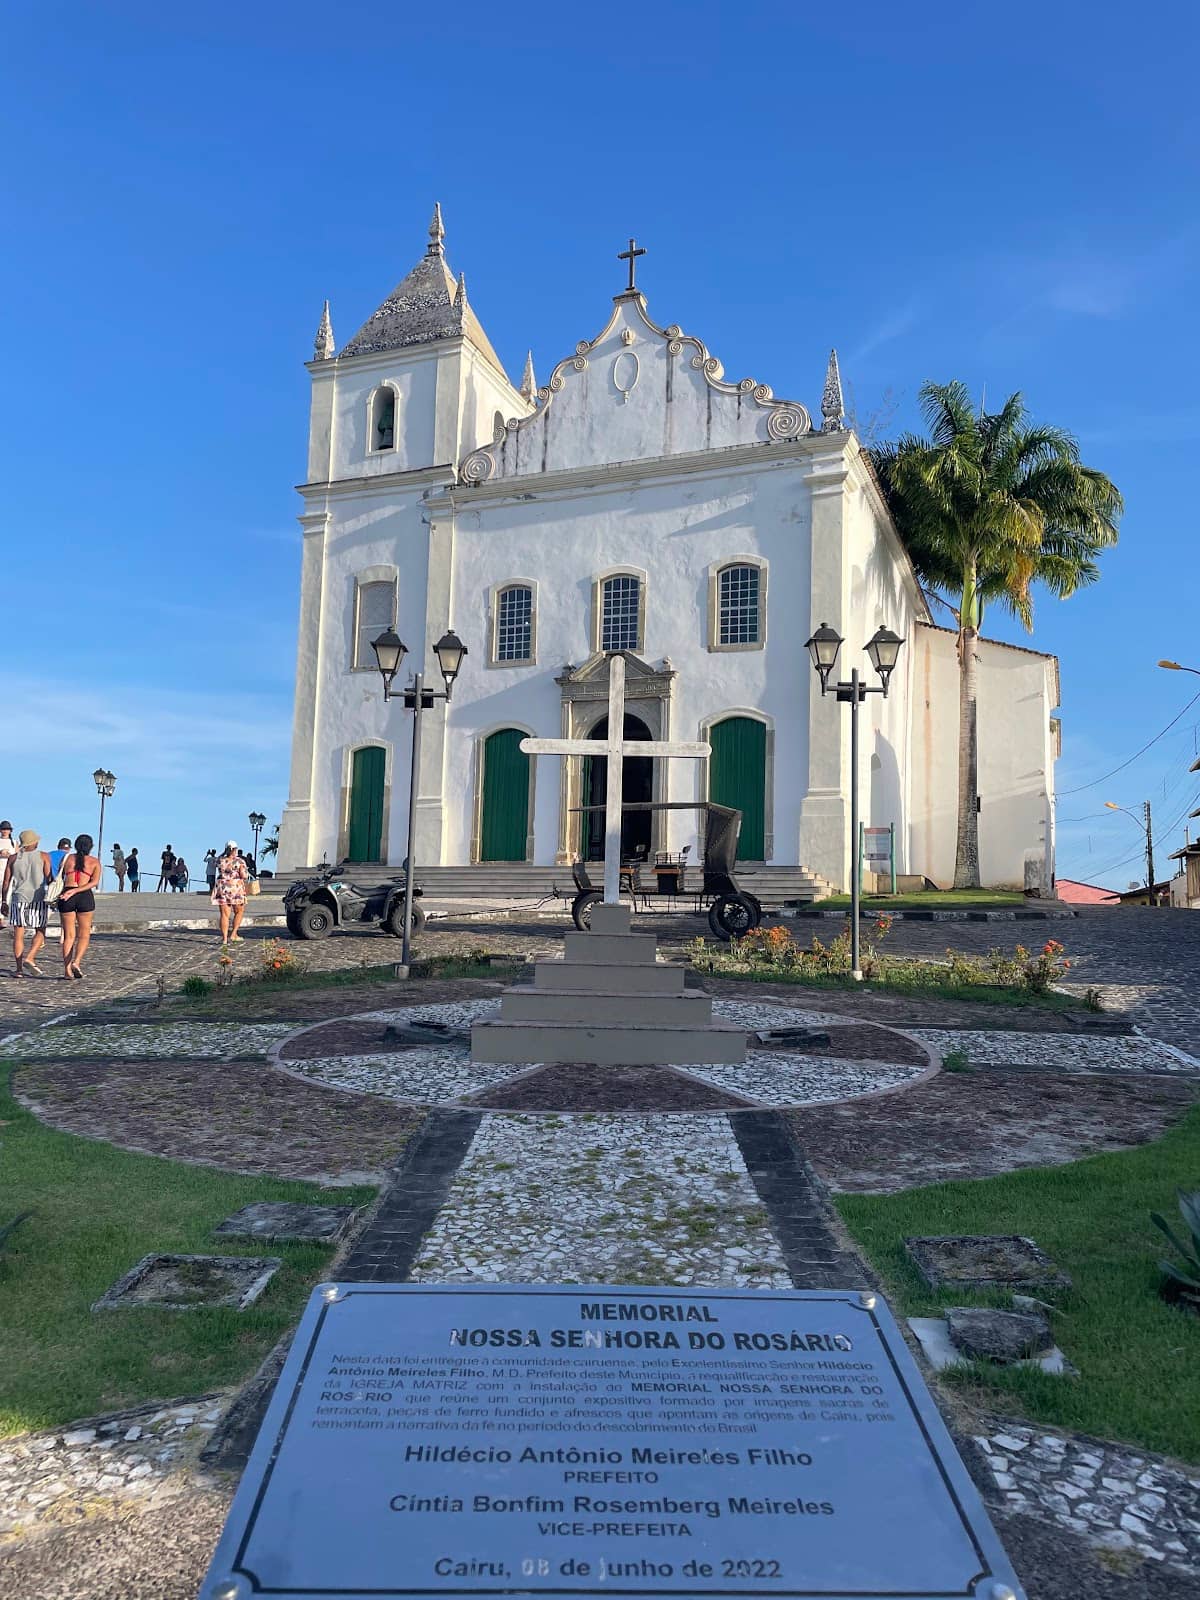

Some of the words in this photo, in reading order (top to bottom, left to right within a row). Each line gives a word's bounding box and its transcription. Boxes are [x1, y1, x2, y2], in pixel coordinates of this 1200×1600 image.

[581, 1303, 719, 1322] MEMORIAL
[450, 1329, 541, 1348] NOSSA
[550, 1330, 680, 1349] SENHORA
[688, 1332, 725, 1350] DO
[734, 1330, 851, 1351] ROSÁRIO
[332, 1355, 370, 1364] Nesta
[372, 1355, 400, 1365] data
[405, 1356, 419, 1365] foi
[492, 1357, 570, 1366] comunidade
[641, 1358, 668, 1368] pelo
[769, 1360, 815, 1369] Senhor
[328, 1366, 384, 1376] Antônio
[388, 1367, 446, 1376] Meireles
[526, 1369, 577, 1379] Prefeito
[580, 1370, 615, 1379] deste
[324, 1379, 341, 1389] da
[350, 1380, 404, 1389] IGREJA
[413, 1380, 467, 1390] MATRIZ
[476, 1383, 504, 1391] com
[530, 1382, 597, 1393] instalação
[606, 1383, 623, 1392] do
[631, 1383, 712, 1392] MEMORIAL
[720, 1384, 772, 1393] NOSSA
[780, 1385, 853, 1394] SENHORA
[861, 1385, 884, 1395] DO
[405, 1395, 431, 1405] que
[488, 1396, 509, 1404] um
[518, 1395, 575, 1406] conjunto
[584, 1396, 651, 1407] expositivo
[660, 1396, 715, 1406] formado
[723, 1399, 745, 1409] por
[434, 1406, 452, 1416] de
[457, 1407, 488, 1417] ferro
[495, 1408, 544, 1418] fundido
[564, 1408, 625, 1418] afrescos
[627, 1411, 652, 1421] que
[658, 1410, 717, 1421] apontam
[311, 1419, 384, 1430] remontam
[397, 1420, 458, 1431] narrativa
[462, 1421, 479, 1431] da
[498, 1422, 515, 1431] no
[573, 1422, 591, 1432] do
[594, 1422, 697, 1433] descobrimento
[405, 1445, 512, 1464] Hildécio
[519, 1446, 623, 1465] Antônio
[631, 1447, 739, 1465] Meireles
[748, 1448, 813, 1466] Filho
[563, 1471, 658, 1484] PREFEITO
[389, 1495, 463, 1513] Cíntia
[473, 1496, 564, 1513] Bonfim
[574, 1497, 720, 1518] Rosemberg
[728, 1498, 835, 1515] Meireles
[538, 1522, 692, 1537] VICE-PREFEITA
[434, 1558, 511, 1580] Cairu,
[559, 1558, 590, 1577] de
[599, 1557, 673, 1582] junho
[682, 1559, 713, 1578] de
[721, 1560, 783, 1578] 2022
